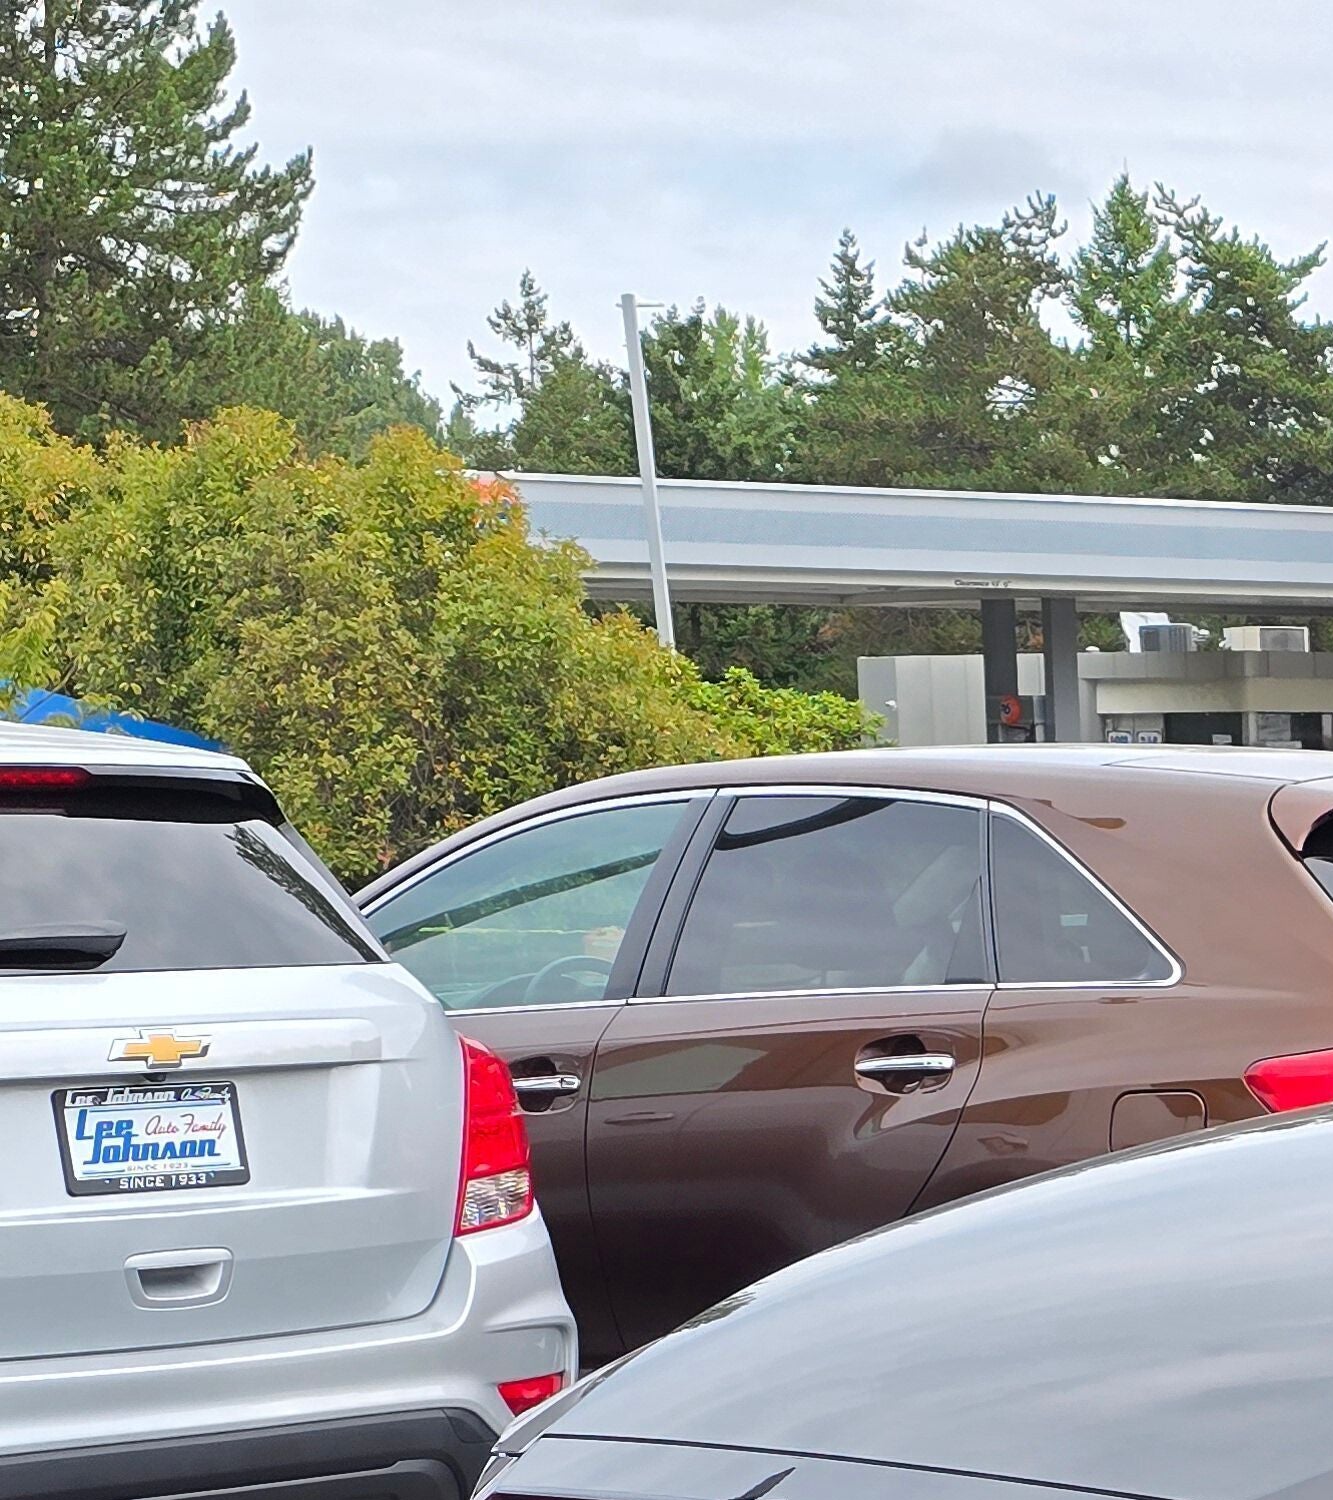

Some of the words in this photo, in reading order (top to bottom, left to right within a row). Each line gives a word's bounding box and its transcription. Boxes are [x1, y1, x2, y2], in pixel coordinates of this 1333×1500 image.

[75, 1109, 139, 1140] Lee
[145, 1115, 179, 1136] Auto
[180, 1112, 227, 1139] Family
[83, 1132, 221, 1165] Johnson
[119, 1176, 165, 1189] SINCE
[171, 1173, 207, 1187] 1933
